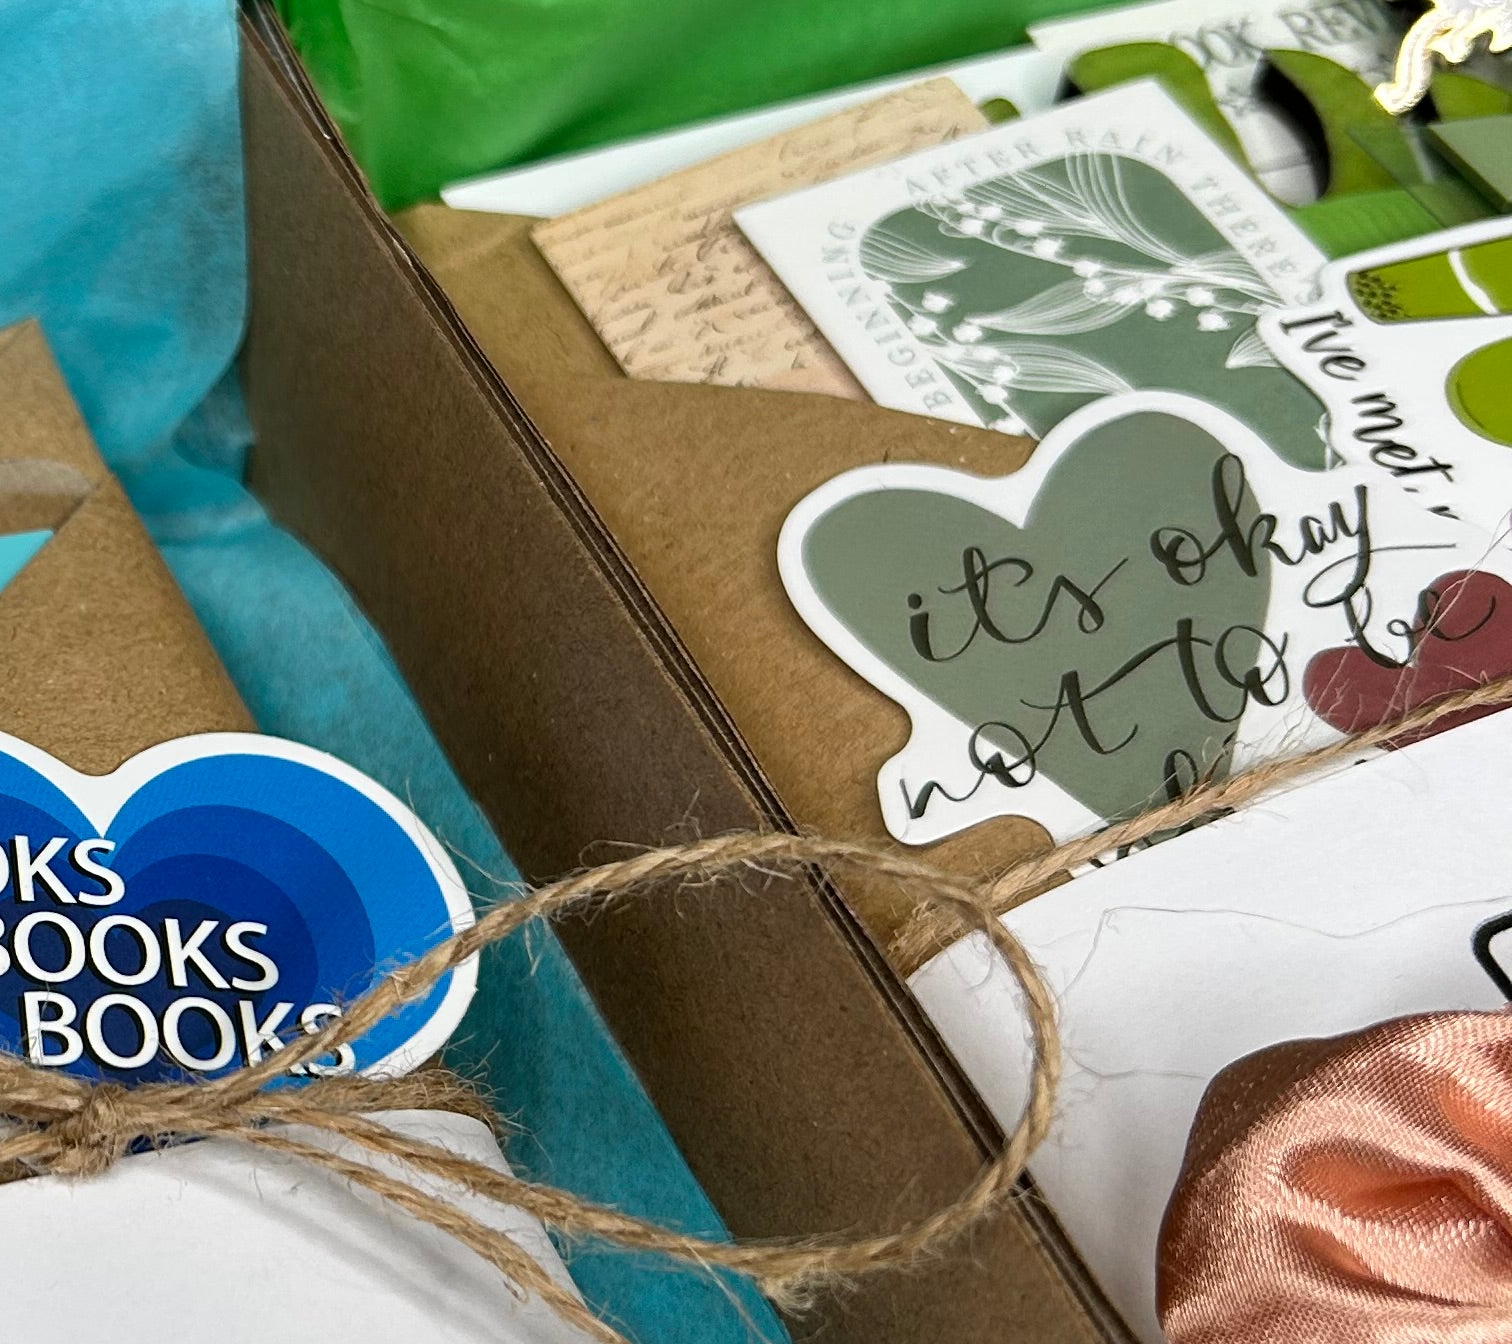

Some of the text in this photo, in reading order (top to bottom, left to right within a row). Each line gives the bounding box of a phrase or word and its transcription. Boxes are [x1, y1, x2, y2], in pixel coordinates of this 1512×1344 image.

[1149, 453, 1456, 609] okay
[899, 669, 1178, 822] not
[1153, 617, 1291, 725] to
[1343, 584, 1497, 670] be
